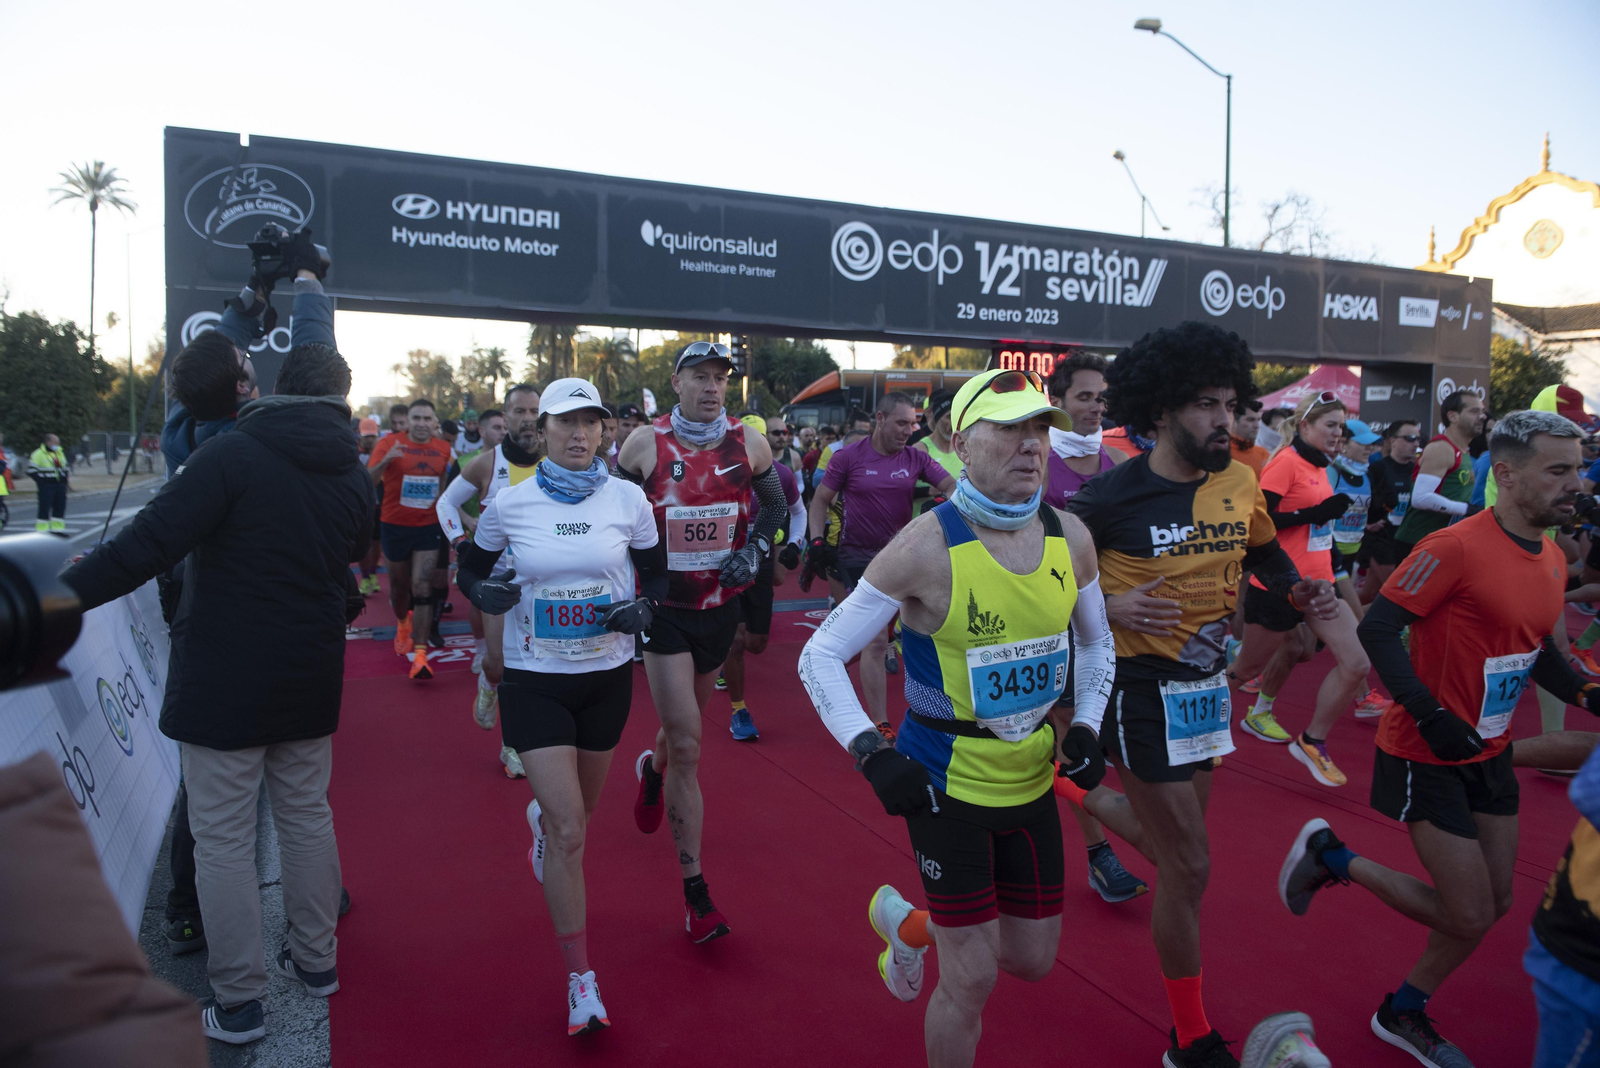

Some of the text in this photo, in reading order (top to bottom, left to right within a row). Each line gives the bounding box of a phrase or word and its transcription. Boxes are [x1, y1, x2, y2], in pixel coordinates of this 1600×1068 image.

[244, 199, 255, 211] de
[255, 198, 291, 216] Canarias
[446, 200, 560, 230] HYUNDAI
[391, 226, 559, 257] Hyundauto Motor
[680, 259, 777, 278] Healthcare Partner
[887, 228, 964, 286] edp
[1012, 245, 1140, 281] maratón
[1045, 275, 1141, 307] sevilla
[1236, 275, 1286, 320] edp
[956, 302, 1059, 325] 29 enero 2023
[1322, 292, 1380, 322] HOKA
[683, 509, 697, 518] edp
[1341, 515, 1362, 527] 1252
[684, 522, 718, 542] 562
[1149, 521, 1247, 546] bichos
[1153, 538, 1247, 558] runners
[550, 589, 565, 598] edp
[1181, 581, 1217, 590] Gestores
[545, 602, 597, 627] 1883
[820, 607, 844, 634] CROSS
[993, 648, 1012, 660] edp
[1504, 659, 1519, 669] edp
[117, 652, 149, 718] edp
[987, 662, 1050, 701] 3439
[1087, 667, 1105, 692] ROSS
[1179, 694, 1216, 724] 1131
[56, 731, 100, 818] dp
